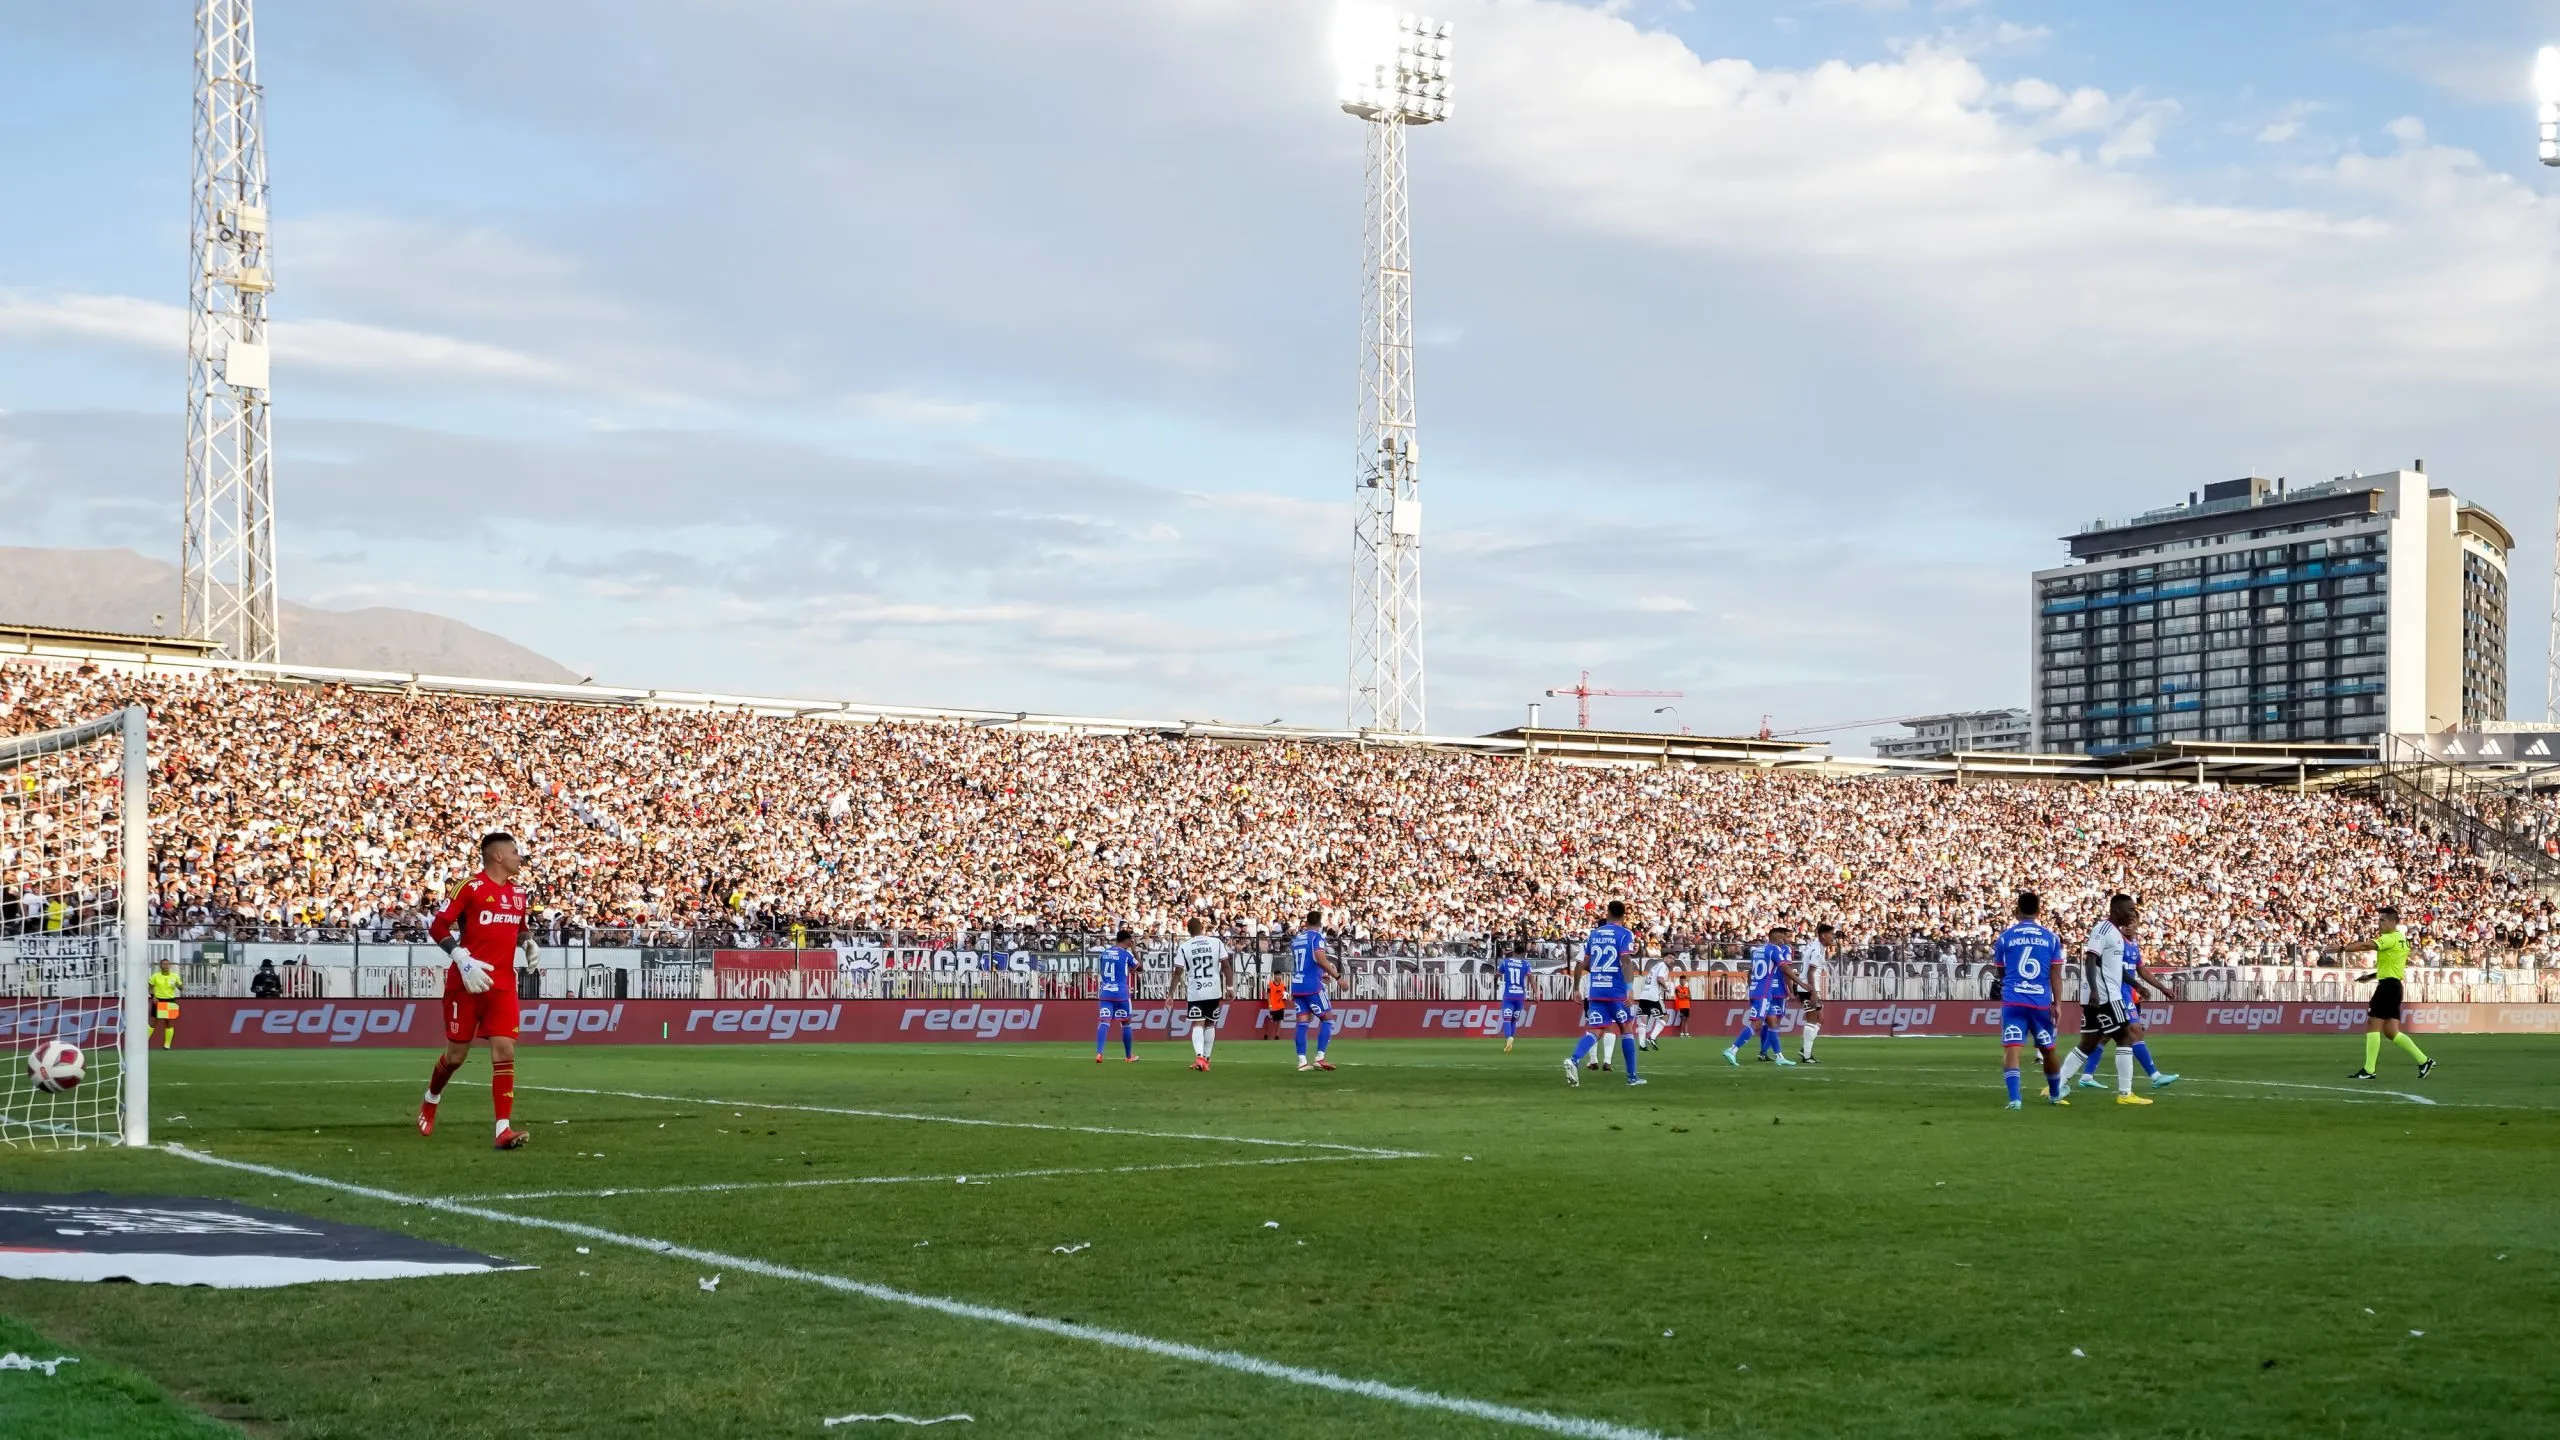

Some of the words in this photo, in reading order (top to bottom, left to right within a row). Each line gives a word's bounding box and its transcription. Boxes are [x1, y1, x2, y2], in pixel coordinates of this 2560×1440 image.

[493, 914, 521, 925] BETAN
[1103, 961, 1116, 981] 4
[1192, 955, 1214, 979] 22
[1293, 948, 1307, 972] 17
[1590, 945, 1619, 973] 22
[2018, 946, 2041, 980] 6
[1508, 967, 1521, 985] 11
[231, 1004, 416, 1042] redgol
[452, 1001, 459, 1020] 1
[518, 1003, 624, 1041] dgol
[685, 1004, 842, 1040] redgol
[900, 1004, 1043, 1038] redgol
[1843, 1004, 1936, 1032] redgol
[2206, 1005, 2283, 1030] redgol
[2299, 1005, 2367, 1030] redgo
[2401, 1005, 2469, 1030] redgol
[2498, 1006, 2560, 1030] redgo
